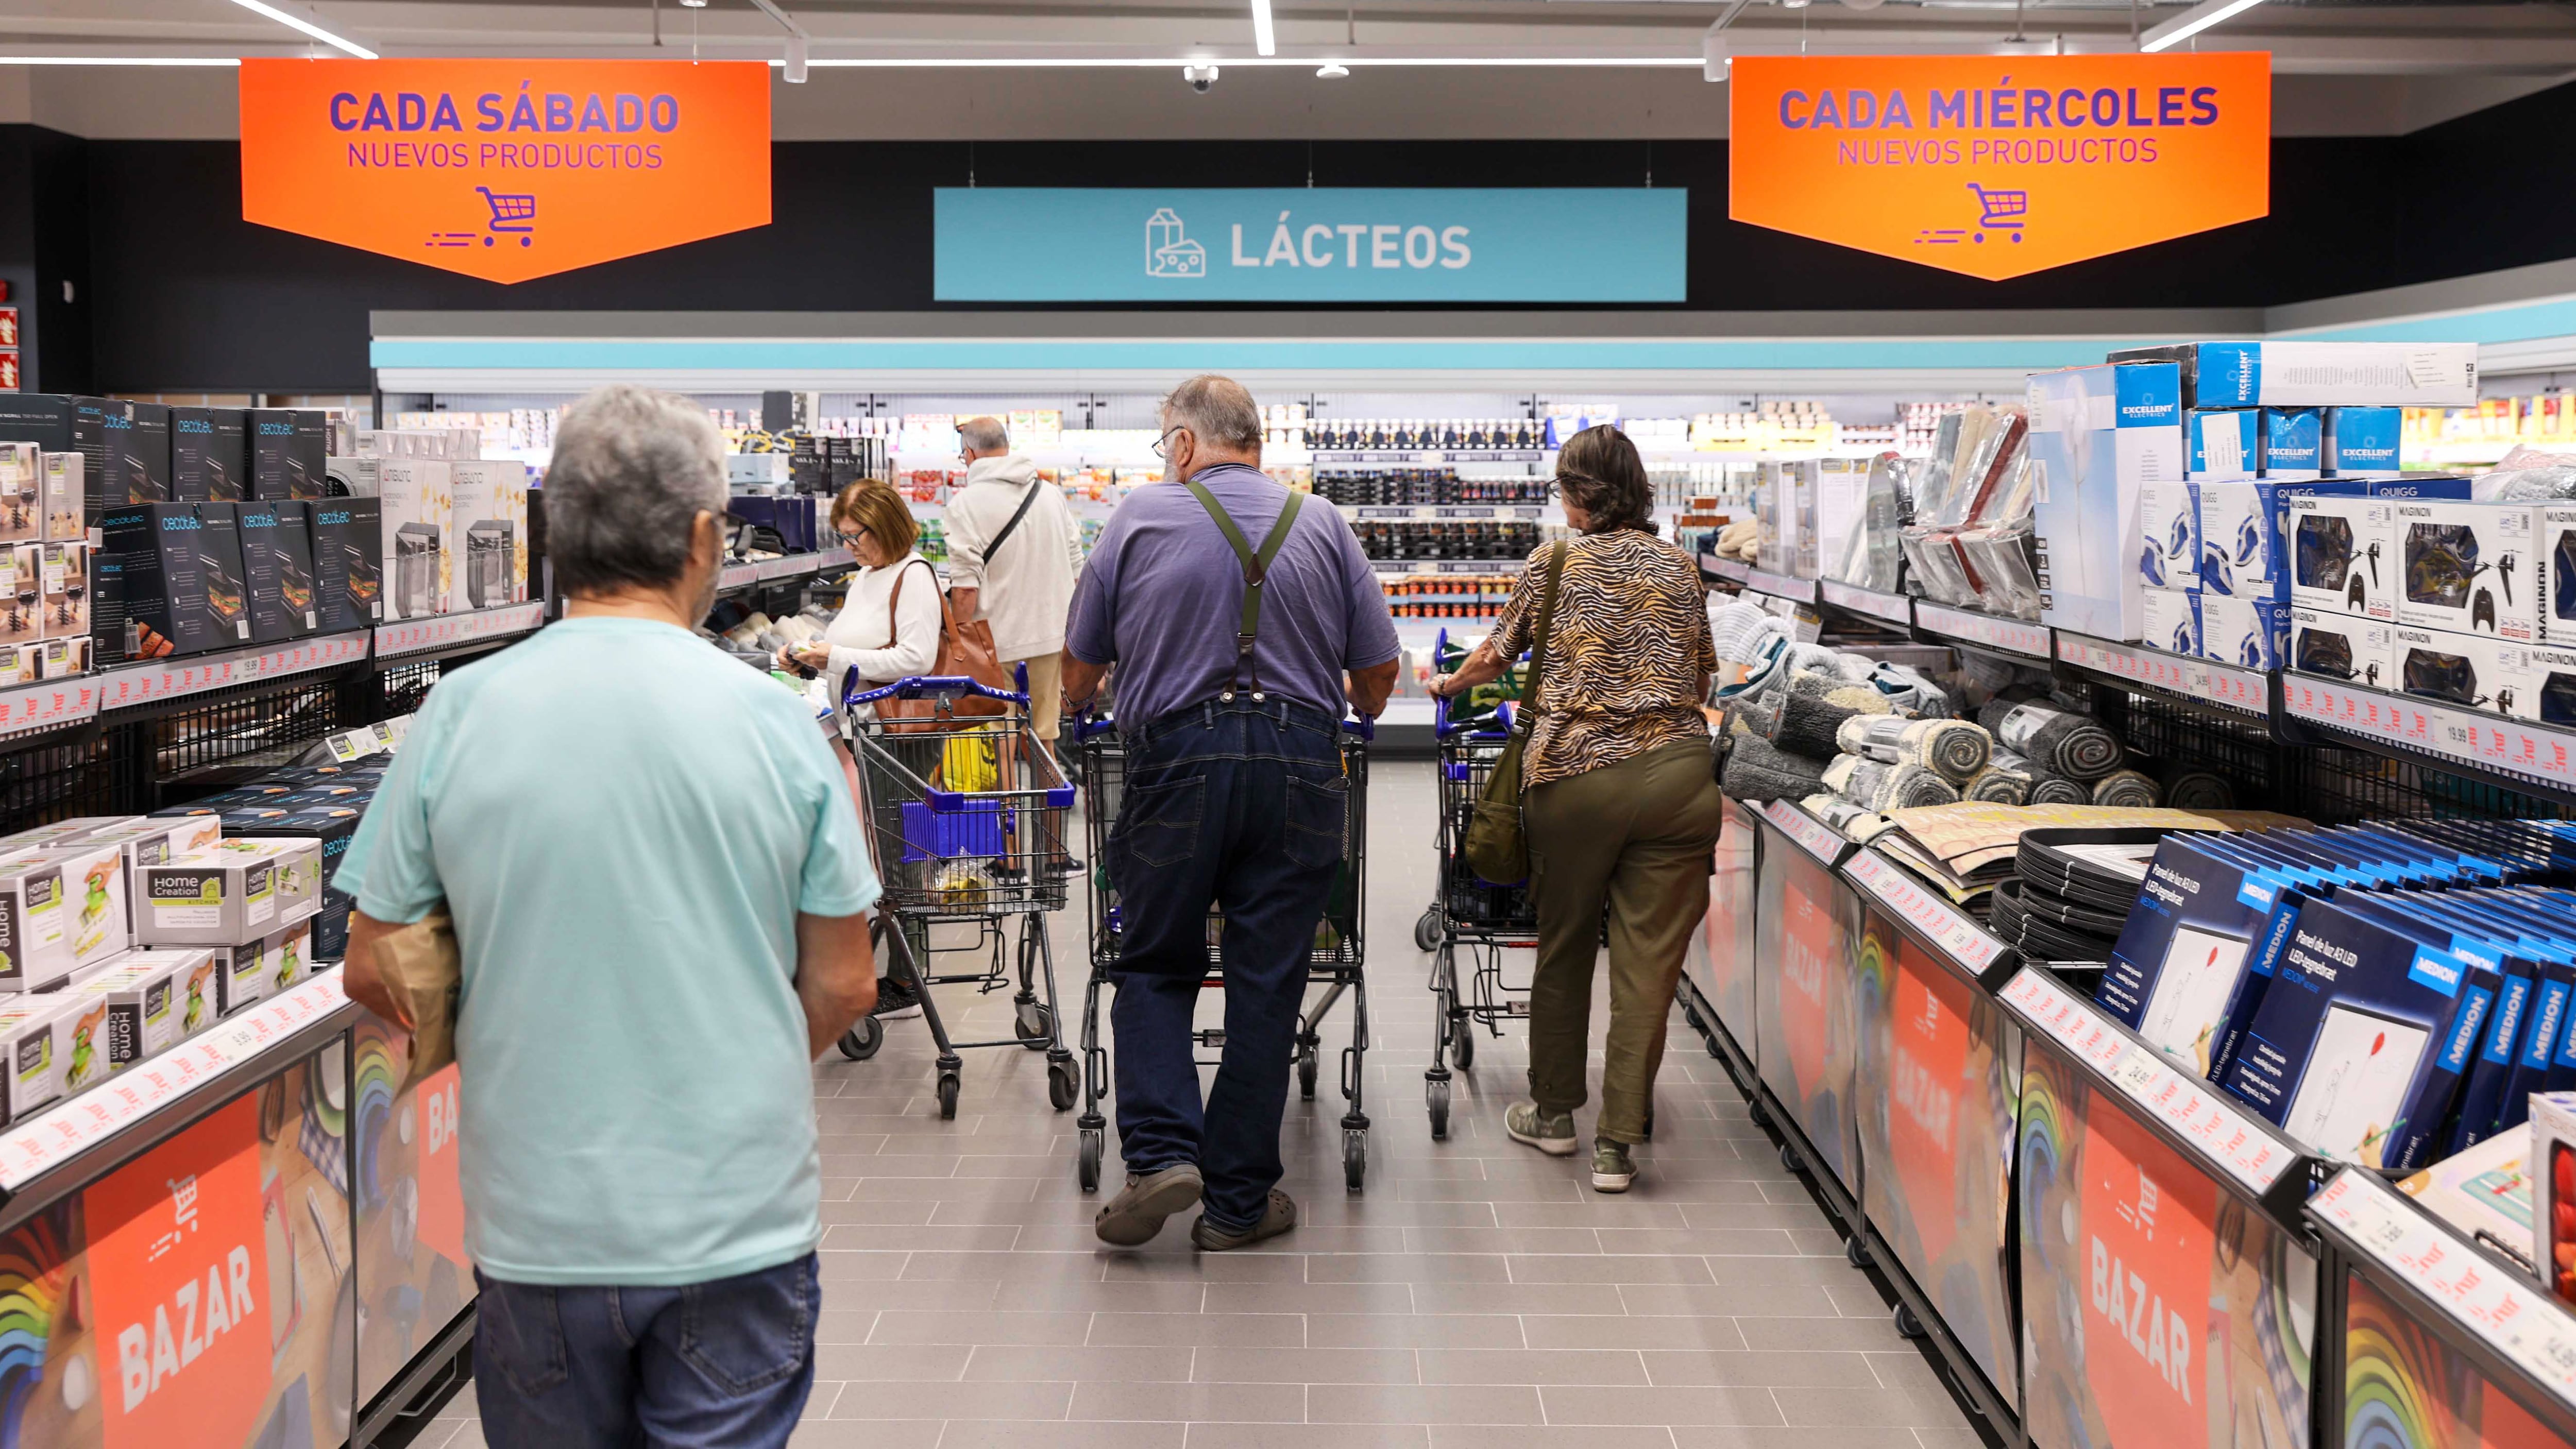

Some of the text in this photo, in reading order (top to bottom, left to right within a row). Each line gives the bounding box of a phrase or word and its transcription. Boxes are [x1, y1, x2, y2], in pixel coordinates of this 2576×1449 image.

[330, 80, 679, 133] CADA SÁBADO
[1779, 75, 2219, 130] CADA MIÉRCOLES
[348, 143, 663, 169] NUEVOS PRODUCTOS
[1838, 138, 2158, 165] NUEVOS PRODUCTOS
[1232, 211, 1471, 269] LÁCTEOS
[2238, 351, 2249, 401] EXCELLENT
[2122, 404, 2173, 414] EXCELLENT
[259, 423, 294, 435] cecotec
[2268, 447, 2313, 456] EXCELLENT
[2343, 448, 2394, 457] EXCELLENT
[2201, 491, 2217, 503] QUIGG
[2277, 488, 2315, 499] QUIGG
[2380, 487, 2418, 498] QUIGG
[317, 511, 350, 525] cecotec
[2399, 507, 2431, 518] MAGINON
[2538, 561, 2547, 639] MAGINON
[2397, 630, 2431, 644] MAGINON
[2448, 726, 2466, 743] 19,99
[323, 833, 352, 857] cecote
[27, 879, 50, 893] Home
[155, 877, 199, 888] Home
[155, 887, 198, 896] Creation
[2242, 882, 2273, 903] MEDION
[0, 900, 10, 947] Home
[2261, 911, 2293, 969] MEDION
[2295, 929, 2317, 949] Panel
[2313, 937, 2325, 953] de
[2342, 950, 2358, 968] LED
[2416, 956, 2459, 985] MEDION
[2448, 994, 2485, 1065] MEDION
[2494, 984, 2526, 1055] MEDION
[2533, 989, 2564, 1061] MEDION
[110, 1012, 119, 1059] Creation
[119, 1012, 132, 1059] Home
[1895, 1046, 1951, 1154] BAZAR
[118, 1244, 255, 1415] BAZAR
[2091, 1235, 2192, 1406] BAZAR
